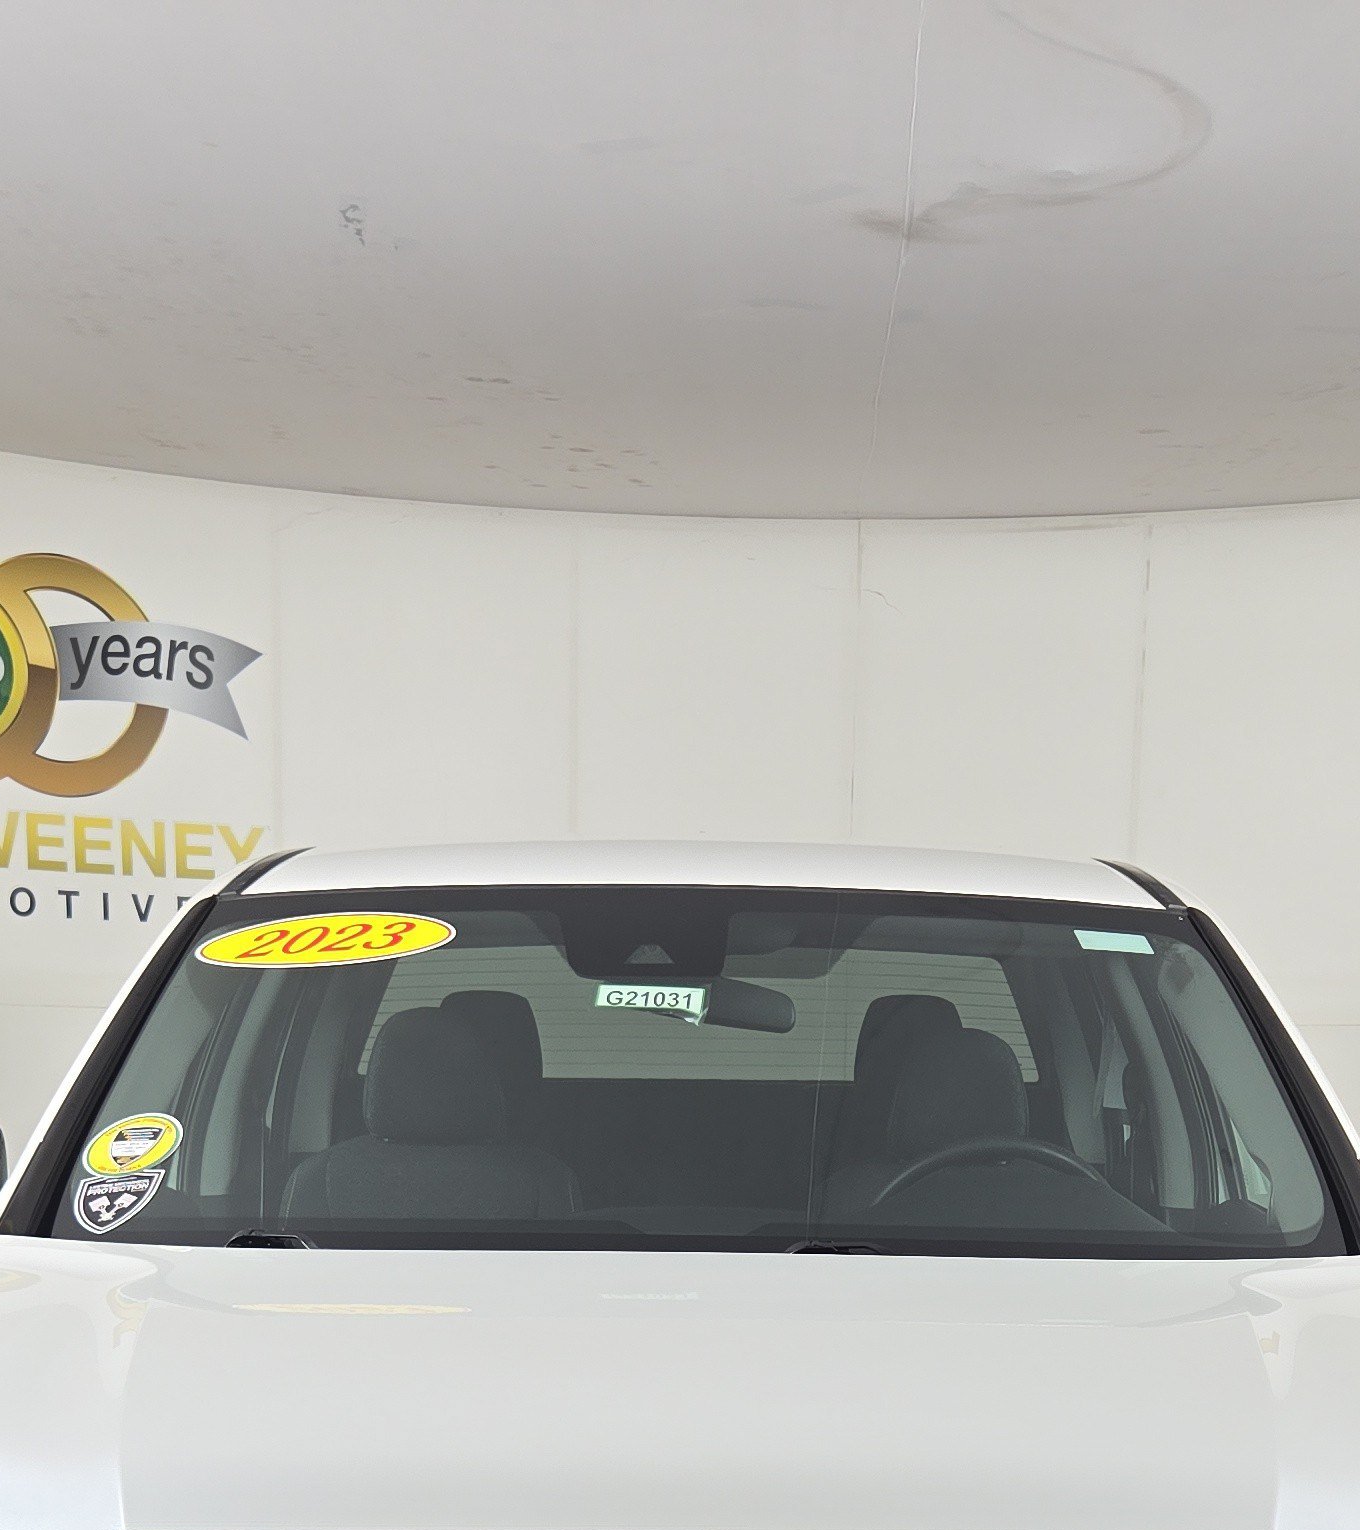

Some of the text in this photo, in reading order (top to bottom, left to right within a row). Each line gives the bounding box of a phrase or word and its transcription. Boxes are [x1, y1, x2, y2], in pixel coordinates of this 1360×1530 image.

[69, 633, 217, 690] years
[235, 921, 416, 959] 2023
[606, 990, 692, 1009] G21031
